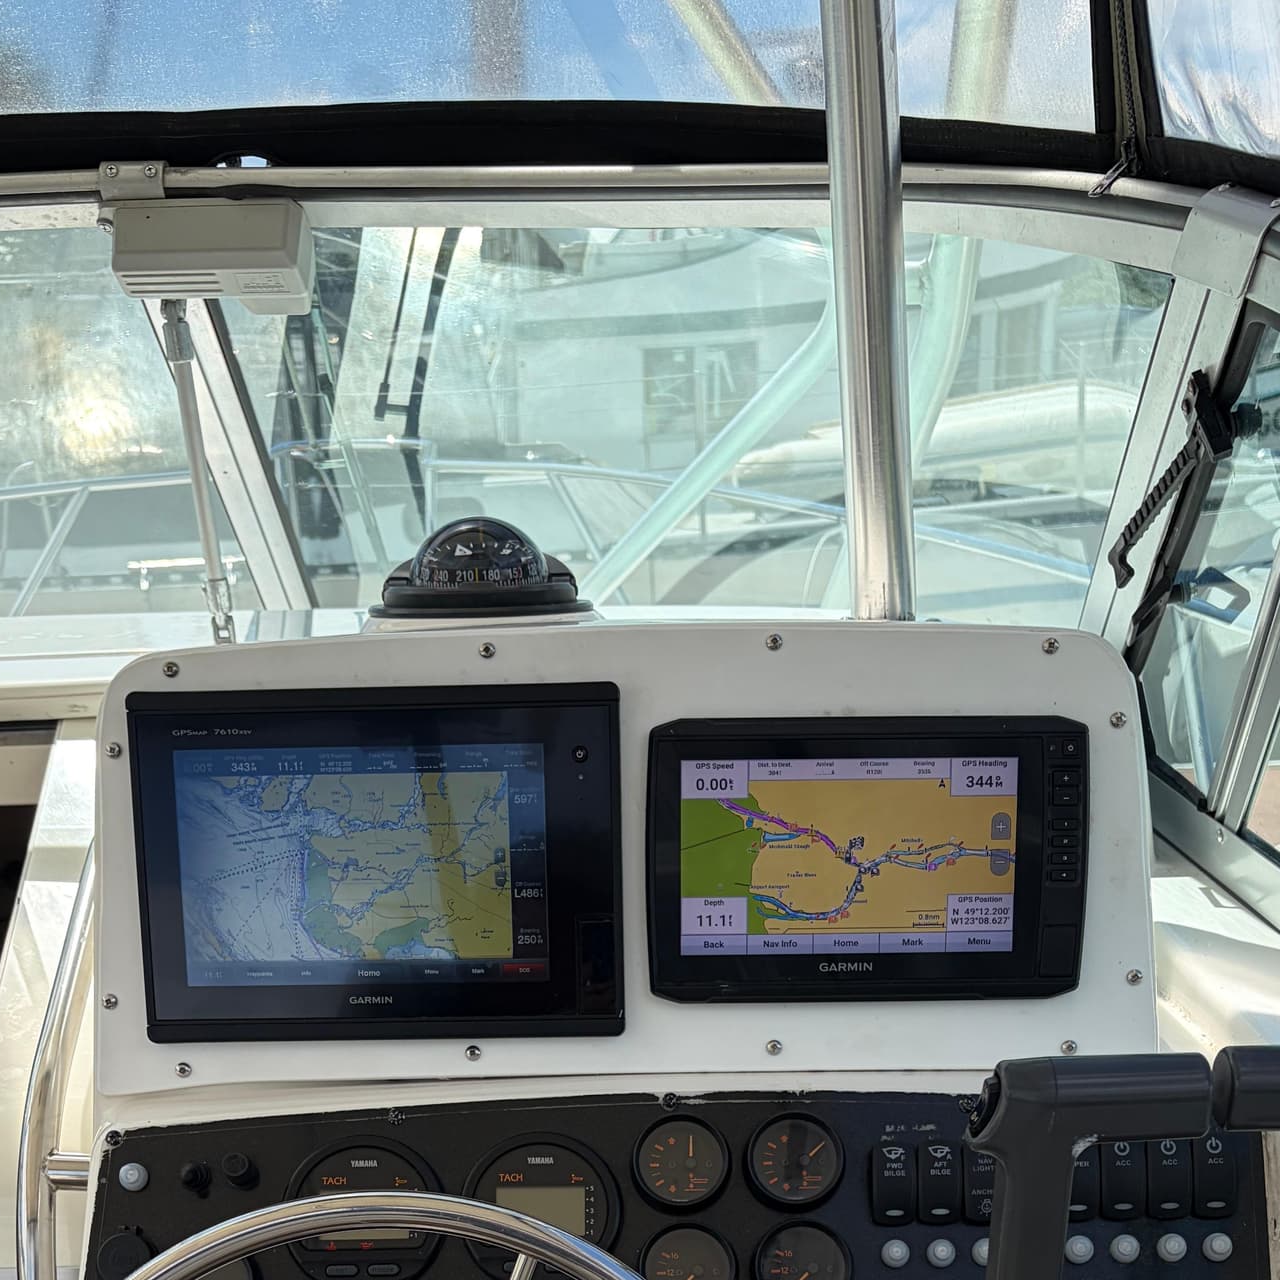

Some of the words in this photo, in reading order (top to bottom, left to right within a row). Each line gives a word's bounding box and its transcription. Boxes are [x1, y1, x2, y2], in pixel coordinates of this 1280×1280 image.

[434, 571, 448, 581] 240
[456, 571, 474, 581] 210
[482, 570, 500, 580] 180
[696, 762, 711, 770] GPS
[712, 762, 734, 770] Speed
[978, 760, 1008, 768] Heading
[704, 899, 724, 907] Depth
[952, 908, 960, 916] N
[704, 941, 725, 949] Back
[763, 940, 779, 948] Nav
[781, 939, 798, 948] Info
[833, 939, 859, 947] Home
[902, 938, 924, 946] Mark
[968, 937, 991, 945] Menu
[819, 962, 873, 972] GARMIN
[358, 969, 381, 977] Home
[349, 996, 393, 1005] GARMIN
[350, 1160, 378, 1168] YAMAHA
[322, 1177, 347, 1185] TACH
[500, 1173, 523, 1182] TACH
